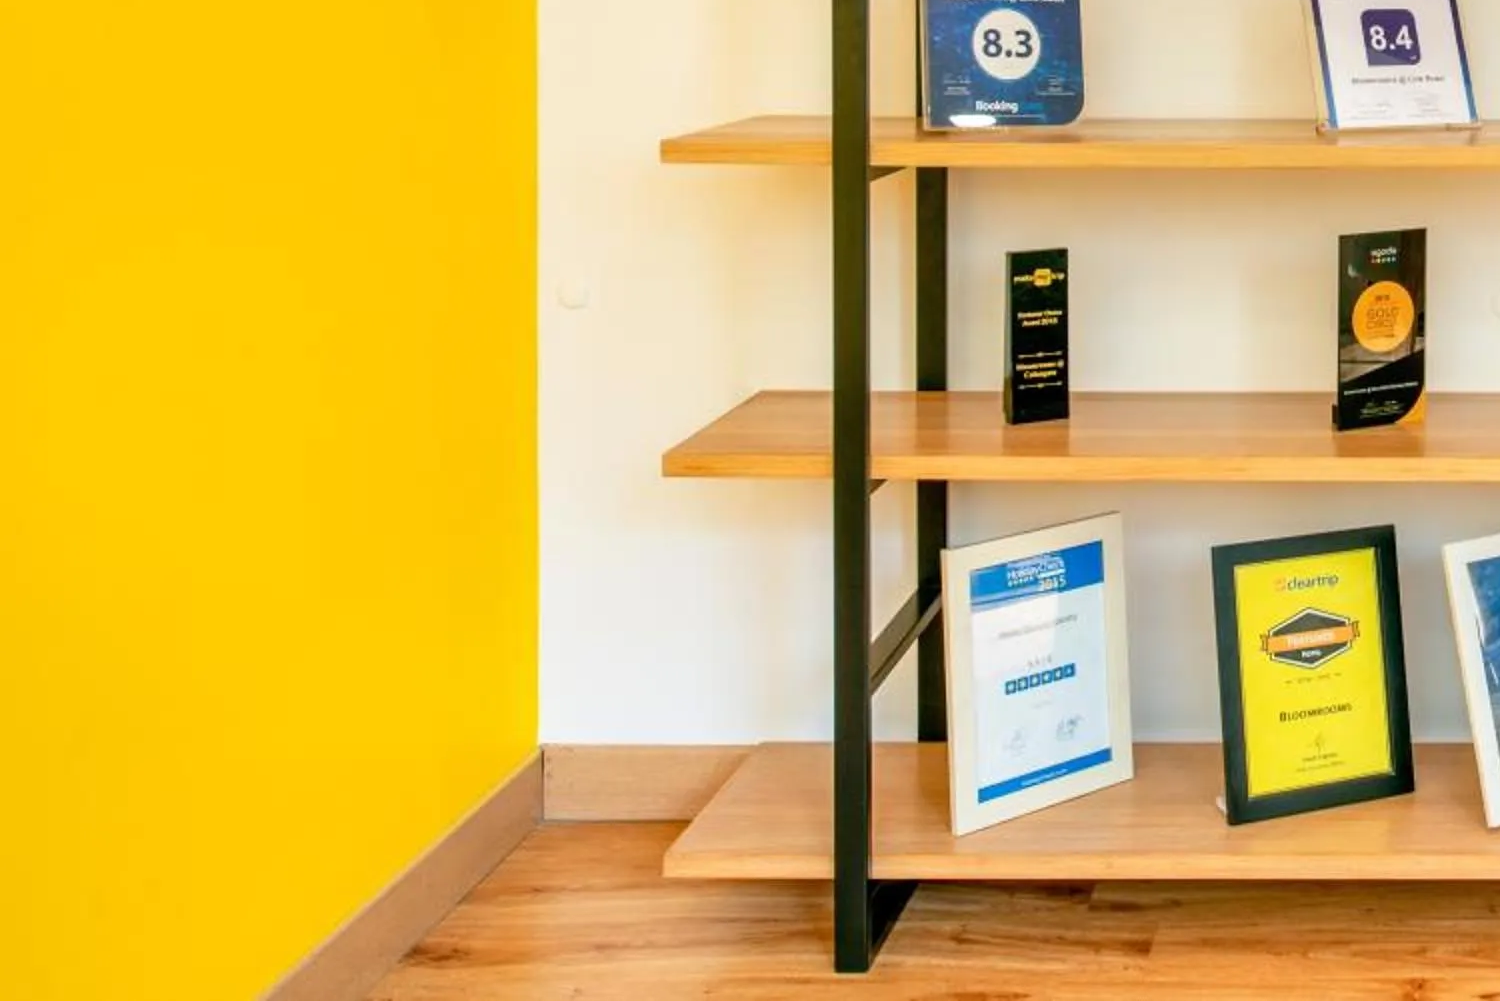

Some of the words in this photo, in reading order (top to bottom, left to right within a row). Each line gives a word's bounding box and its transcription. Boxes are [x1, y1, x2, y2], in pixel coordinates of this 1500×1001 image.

[981, 28, 1034, 59] 8.3
[1368, 24, 1414, 51] 8.4
[1287, 574, 1339, 591] cleartrip
